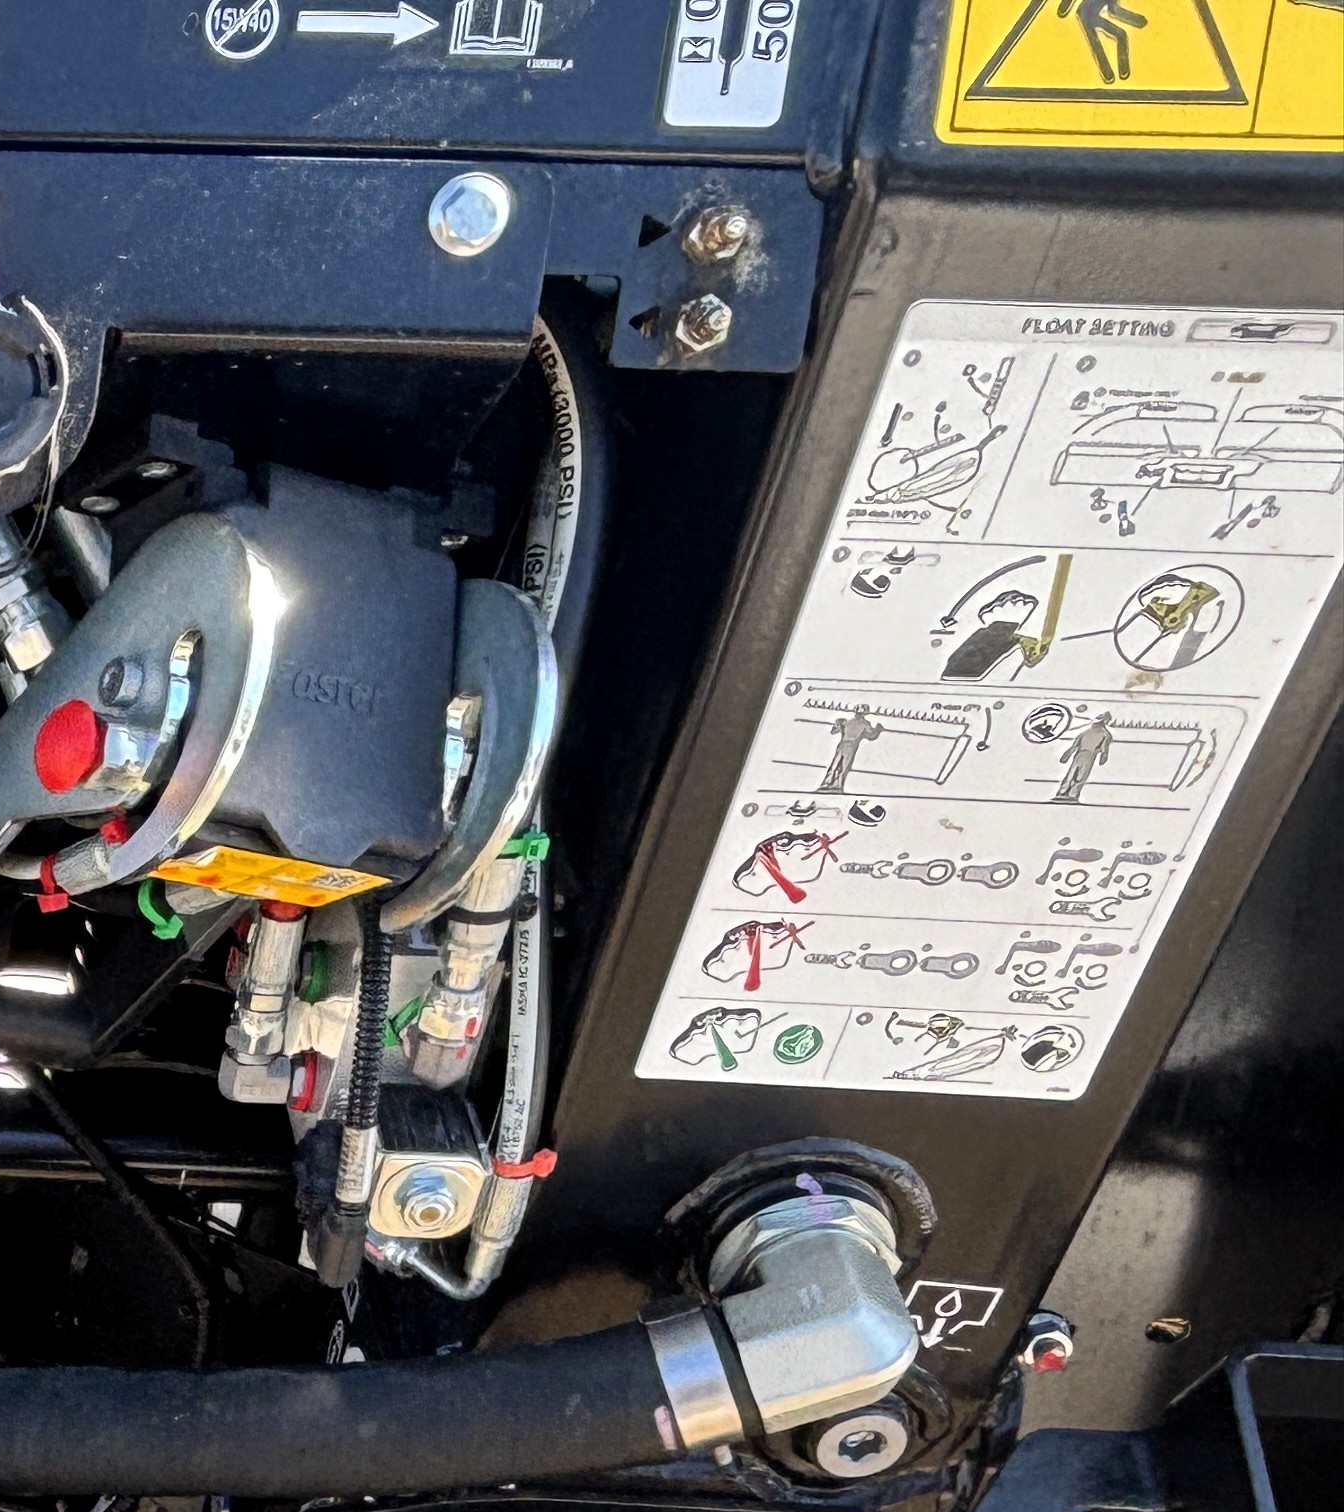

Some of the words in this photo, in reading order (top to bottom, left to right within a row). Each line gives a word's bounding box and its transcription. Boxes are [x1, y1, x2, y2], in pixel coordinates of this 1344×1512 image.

[1020, 317, 1086, 336] FLOAT
[550, 388, 576, 460] (3000
[558, 464, 576, 520] PSI)
[523, 543, 549, 593] PSI)
